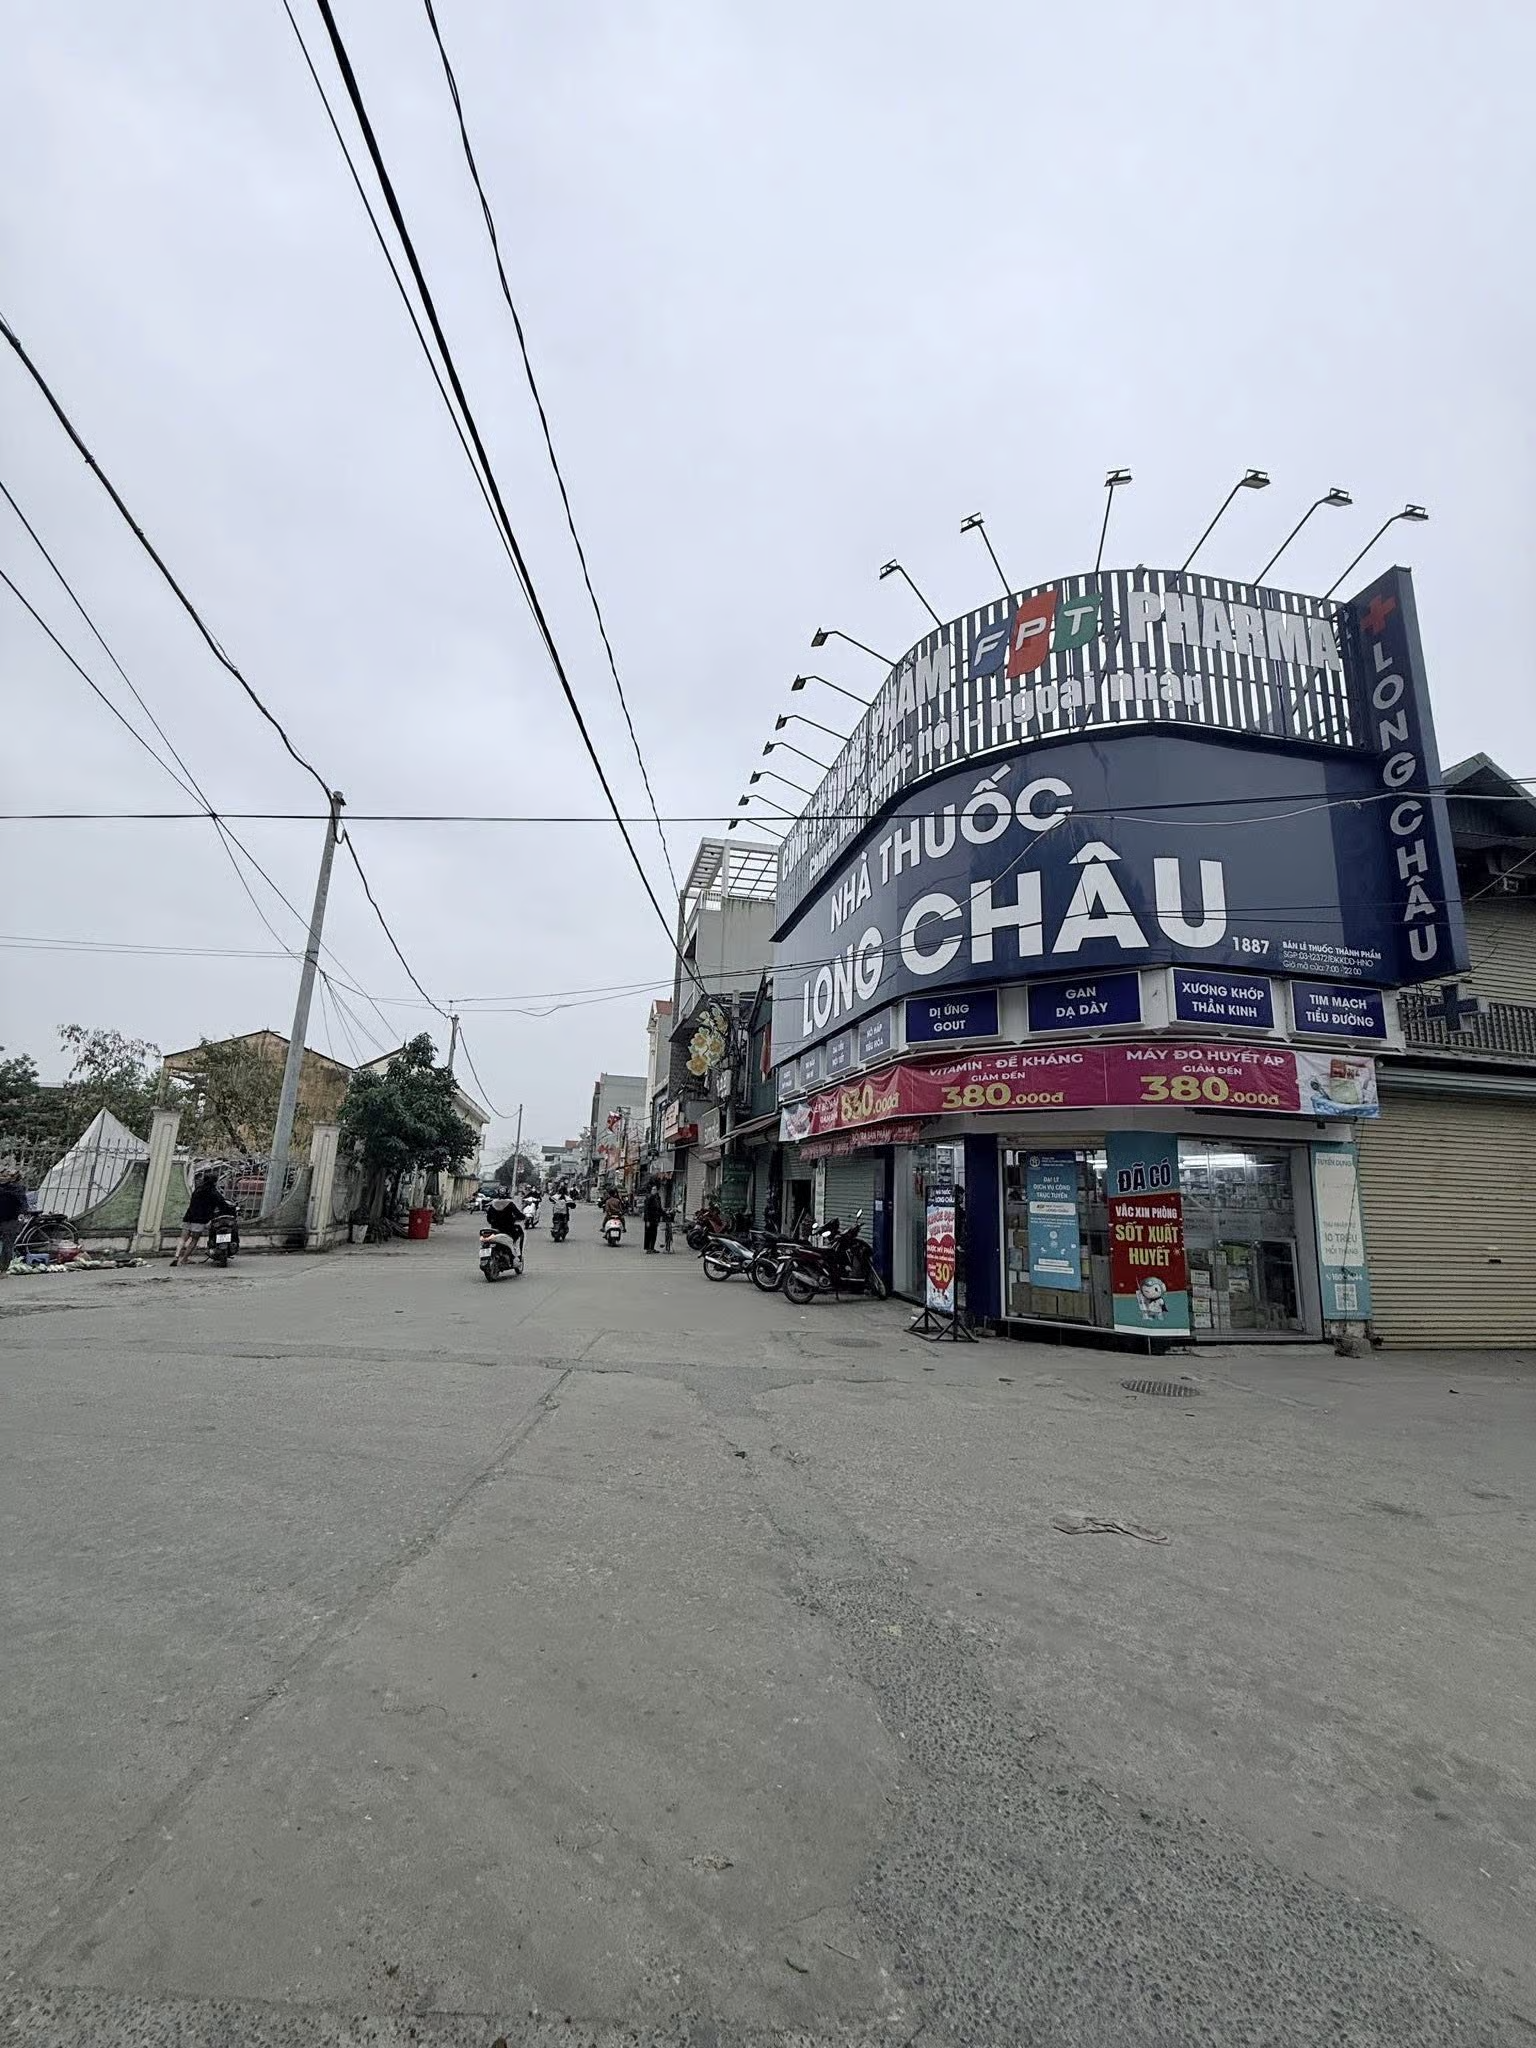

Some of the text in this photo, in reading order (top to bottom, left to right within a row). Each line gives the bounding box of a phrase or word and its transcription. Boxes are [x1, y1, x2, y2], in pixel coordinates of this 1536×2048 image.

[872, 644, 950, 736] PHẨM
[972, 598, 1098, 673] FPT
[1127, 591, 1342, 671] PHARMA
[918, 711, 960, 759] nội
[991, 671, 1096, 728] ngoại
[1110, 667, 1203, 709] nhập
[1373, 642, 1438, 961] LONG CHÂU
[830, 764, 1073, 932] NHÀ THUỐC
[802, 841, 1228, 1038] LONG CHÂU
[1232, 936, 1270, 955] 1887
[1282, 940, 1298, 949] BÁN
[1308, 944, 1334, 954] THUỐC
[1335, 947, 1360, 957] THÀNH
[1361, 949, 1382, 960] PHẨM
[1065, 986, 1097, 1000] GAN
[1182, 982, 1265, 1001] XƯƠNG KHỚP
[929, 1003, 970, 1019] DỊ ỨNG
[1055, 999, 1109, 1020] DẠ DÀY
[1192, 998, 1257, 1017] THẦN KINH
[1309, 993, 1367, 1012] TIM MẠCH
[933, 1020, 966, 1033] GOUT
[1305, 1008, 1375, 1028] TIỂU ĐƯỜNG
[929, 1059, 983, 1077] VITAMIN
[995, 1055, 1018, 1069] ĐỀ
[1023, 1050, 1083, 1067] KHÁNG
[1126, 1047, 1285, 1066] MÁY ĐO HUYẾT ÁP
[971, 1070, 1026, 1082] GIẢM ĐẾN
[1182, 1063, 1243, 1076] GIẢM ĐẾN
[1117, 1158, 1172, 1193] ĐÃ CÓ
[1135, 1207, 1150, 1218] XIN
[1151, 1205, 1177, 1219] PHÒNG
[1115, 1220, 1143, 1241] SỐT
[1148, 1221, 1178, 1243] XUẤT
[1129, 1246, 1170, 1266] HUYẾT
